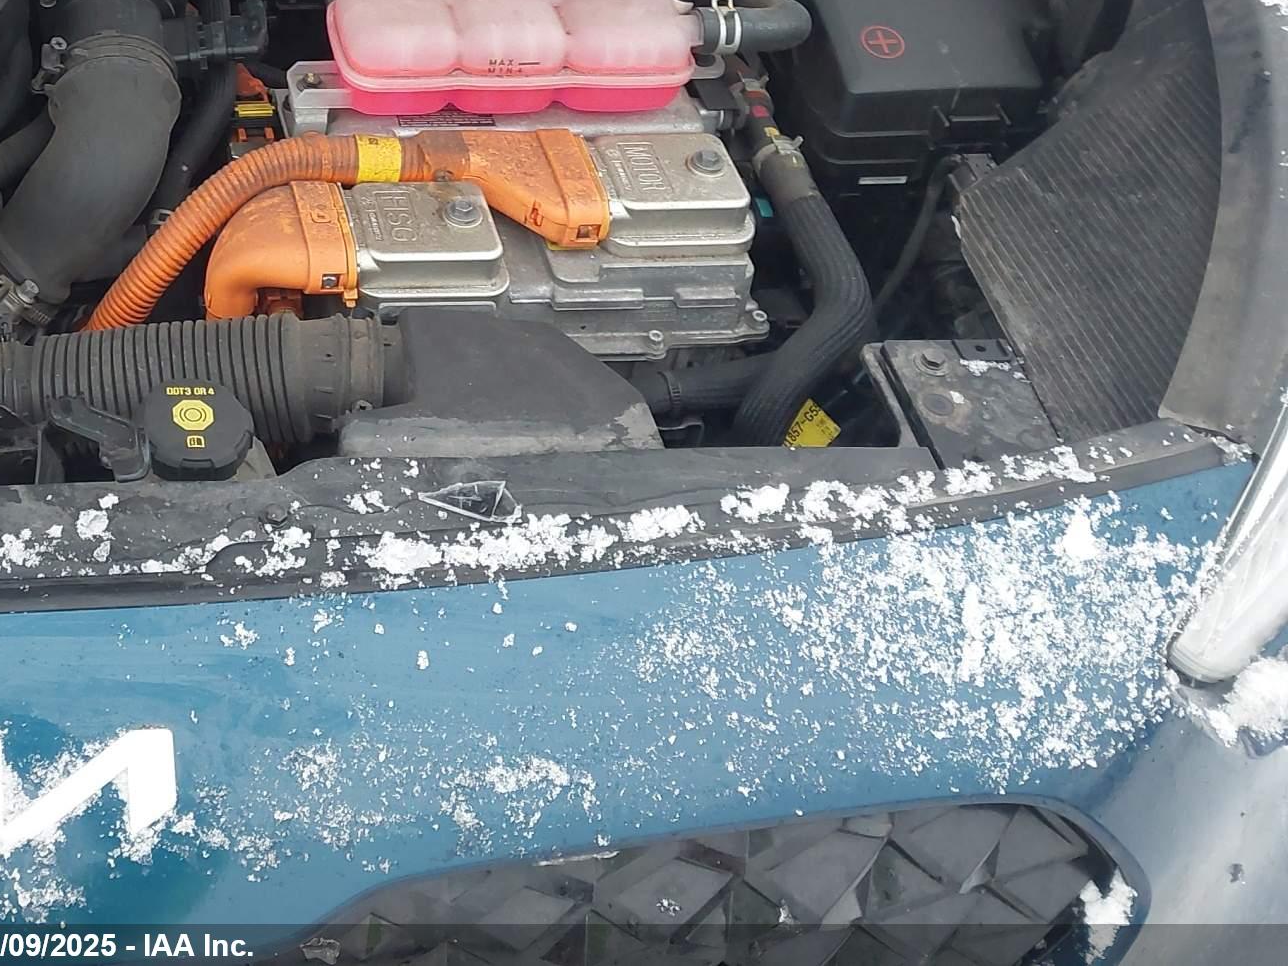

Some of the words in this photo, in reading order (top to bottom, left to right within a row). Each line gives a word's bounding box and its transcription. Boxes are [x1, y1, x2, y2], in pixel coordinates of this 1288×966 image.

[488, 58, 514, 66] MAX
[623, 145, 667, 191] MOTOR
[166, 387, 192, 396] DOT3
[193, 387, 207, 396] OR
[208, 387, 215, 396] 4
